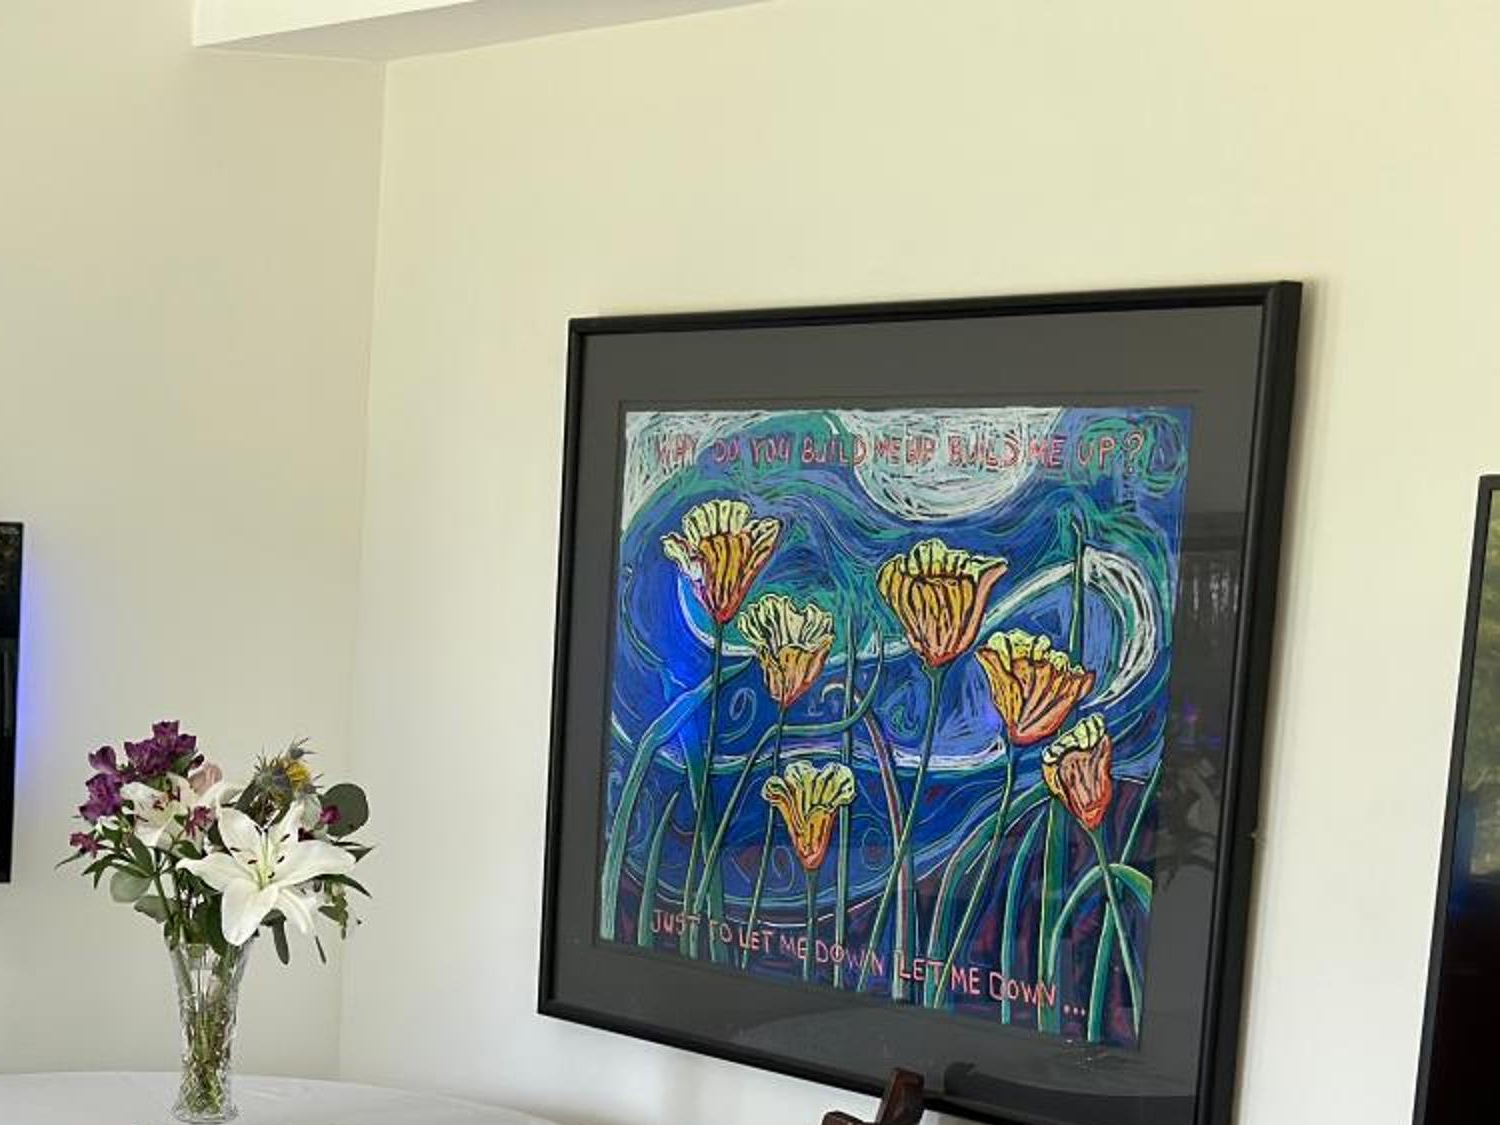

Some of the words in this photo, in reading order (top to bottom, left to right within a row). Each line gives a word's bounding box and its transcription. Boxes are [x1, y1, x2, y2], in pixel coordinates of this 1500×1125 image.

[656, 433, 698, 465] WHY
[713, 437, 740, 463] DO
[752, 436, 791, 464] YOU
[802, 436, 868, 466] BUILD
[948, 433, 1021, 470] BUILD
[1028, 436, 1067, 468] ME
[650, 909, 700, 936] JUST
[710, 920, 733, 943] TO
[739, 928, 774, 954] LET
[779, 935, 808, 960] ME
[815, 939, 886, 976] DOWN
[900, 958, 944, 986] LET
[951, 964, 981, 995] ME
[989, 970, 1057, 1008] DOWN
